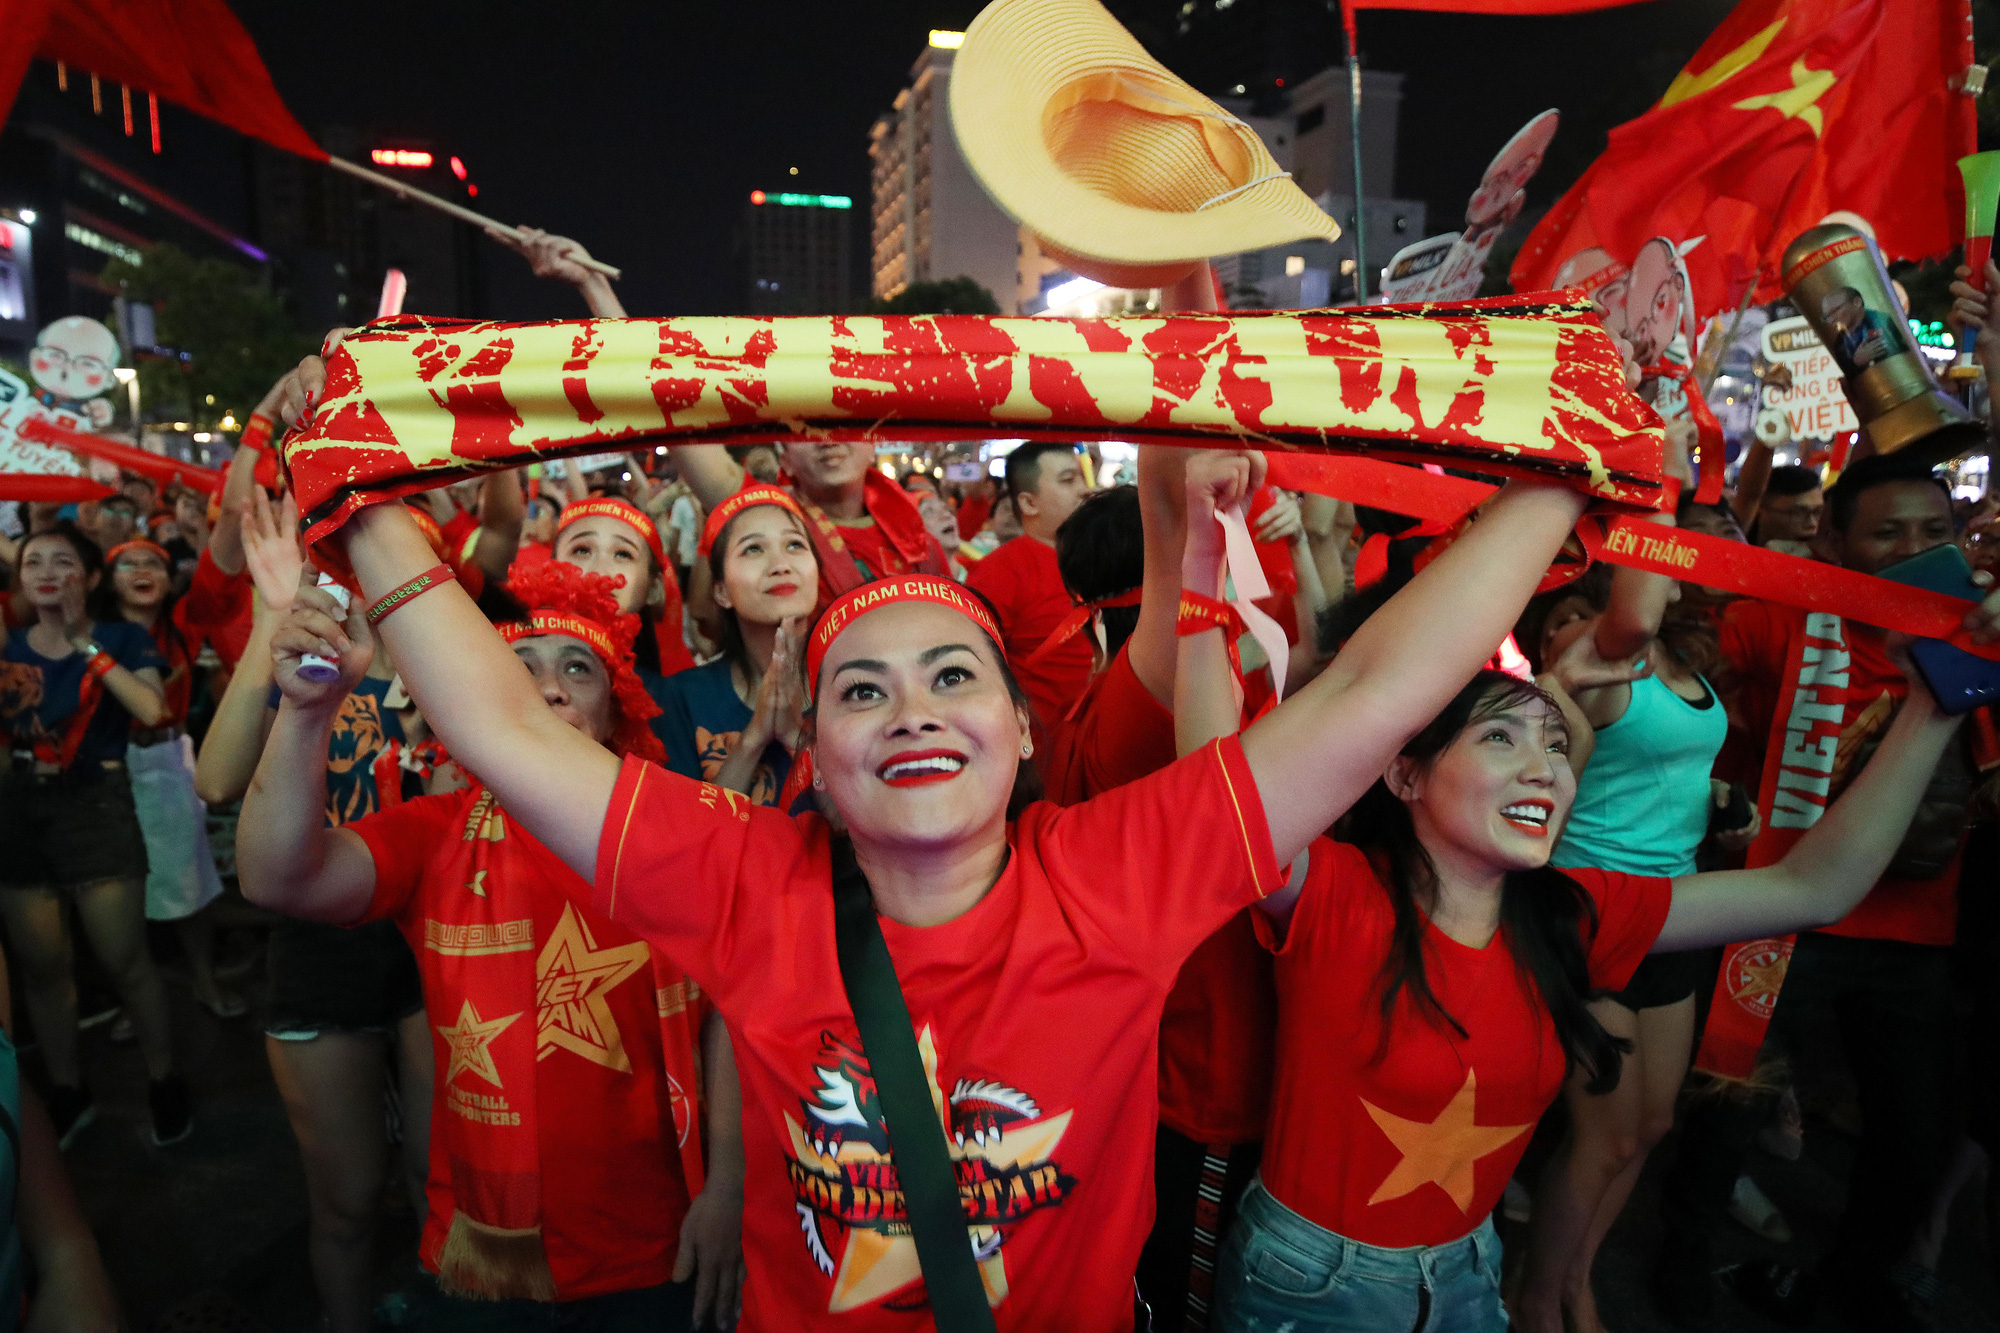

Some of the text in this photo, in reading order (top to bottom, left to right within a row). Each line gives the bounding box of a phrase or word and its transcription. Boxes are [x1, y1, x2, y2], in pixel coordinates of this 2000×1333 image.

[1788, 397, 1849, 434] VIỆT
[744, 490, 771, 502] NAM
[1602, 527, 1699, 569] IẾN THẮNG
[819, 604, 848, 645] VIỆT
[853, 584, 899, 612] NAM
[904, 581, 963, 607] CHIẾN
[1769, 612, 1851, 829] VIETNA
